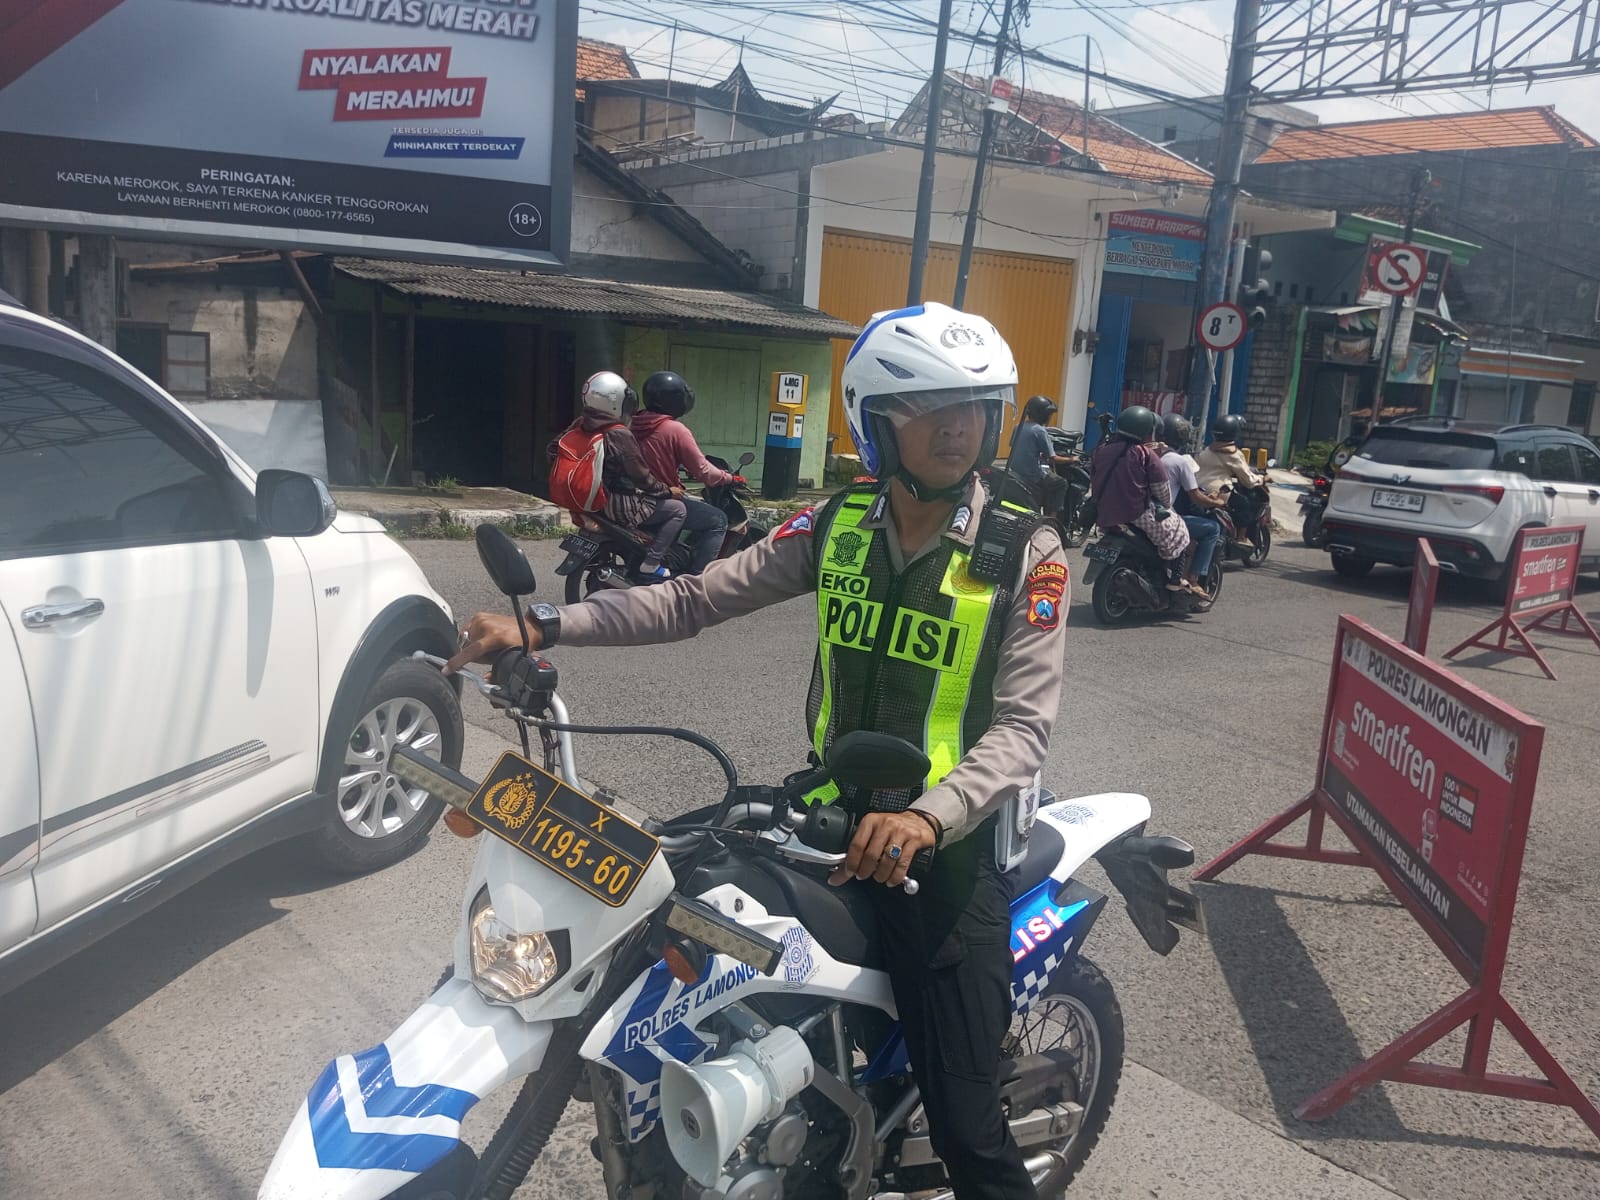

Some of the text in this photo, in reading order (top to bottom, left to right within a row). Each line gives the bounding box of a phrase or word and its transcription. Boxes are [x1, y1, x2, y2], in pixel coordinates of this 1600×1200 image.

[428, 3, 536, 38] MERAH
[309, 53, 442, 76] NYALAKAN
[346, 87, 475, 111] MERAHMU!
[392, 127, 439, 135] TERSEDIA
[441, 127, 467, 135] JUGA
[393, 141, 516, 151] MINIMARKET TERDEKAT
[200, 168, 295, 187] PERINGATAN:
[57, 171, 429, 214] KARENA MEROKOK, SAYA TERKENA KANKER TENGGOROKAN
[117, 192, 375, 225] LAYANAN BERHENTI MEROKOK (0800-177-6565)
[513, 213, 537, 225] 18+
[1111, 213, 1155, 230] SUMBER
[1209, 314, 1237, 337] 8 T
[784, 377, 800, 387] LMG
[785, 388, 795, 399] 11
[821, 573, 865, 595] EKO
[894, 613, 960, 668] ISI
[1367, 650, 1492, 756] POLRES LAMONGAN
[1350, 700, 1436, 800] smartfren
[590, 811, 611, 833] X
[1439, 799, 1472, 829] INDONESIA
[530, 818, 632, 895] 1195-60
[1346, 790, 1451, 920] UTAMAKAN KESELAMATAN
[624, 962, 760, 1053] POLRES LAMONG
